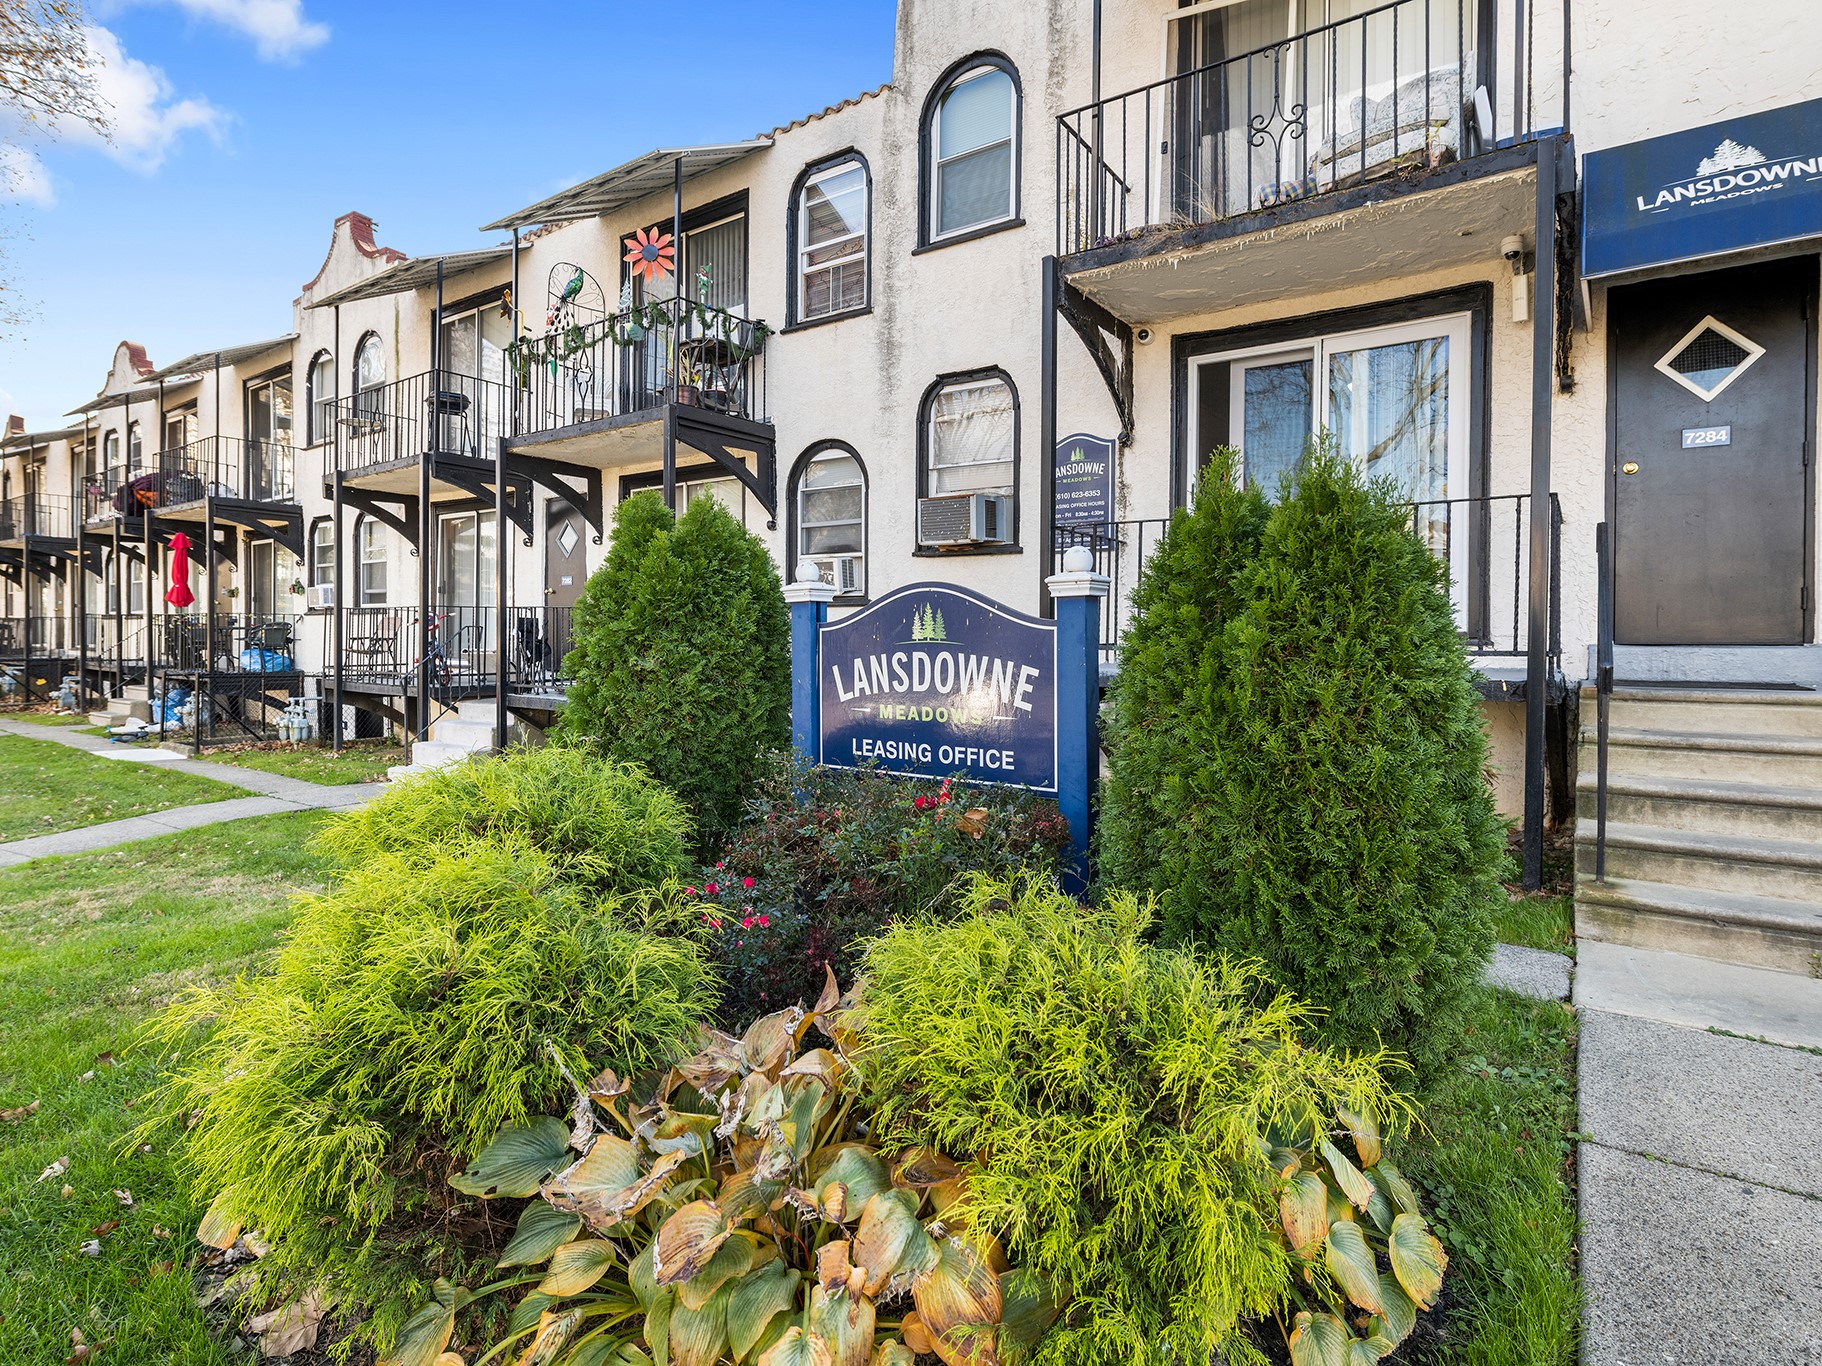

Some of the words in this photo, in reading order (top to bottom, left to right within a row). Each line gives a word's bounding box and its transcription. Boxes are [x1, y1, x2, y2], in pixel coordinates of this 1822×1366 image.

[1637, 156, 1822, 211] LANSDOWN
[1690, 182, 1784, 207] MEADOWS
[1685, 429, 1728, 444] 7284
[1056, 463, 1105, 478] ANSDOWNE
[1072, 490, 1100, 498] 623-6353
[832, 651, 1040, 712] LANSDOWNE
[879, 704, 983, 725] MEADOWS
[852, 737, 932, 763] LEASING
[938, 746, 1015, 770] OFFICE
